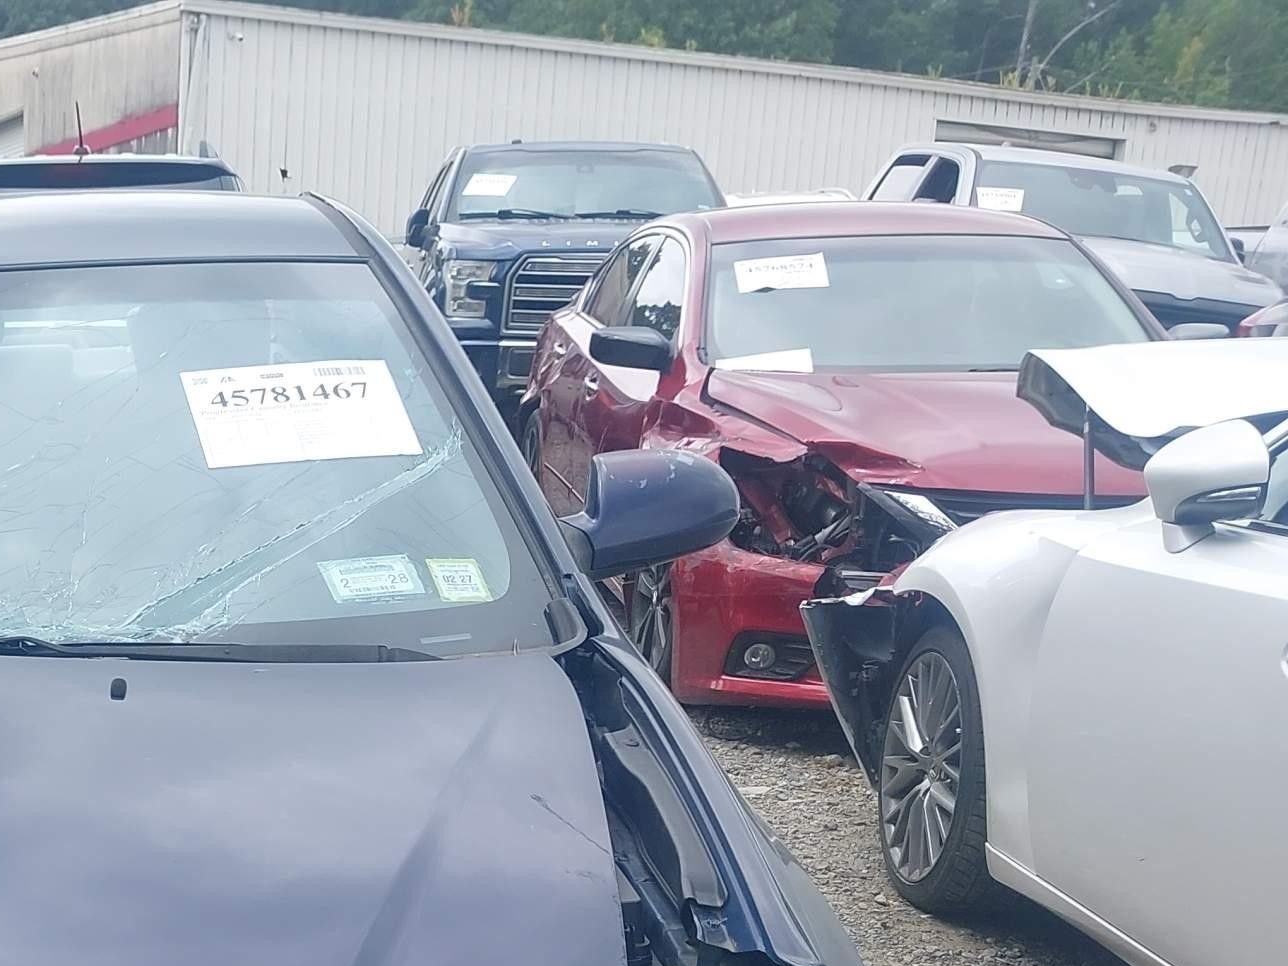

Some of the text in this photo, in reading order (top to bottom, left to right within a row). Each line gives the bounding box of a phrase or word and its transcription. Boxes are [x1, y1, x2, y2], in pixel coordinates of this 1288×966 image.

[210, 381, 367, 408] 45781467
[340, 577, 352, 589] 2
[387, 572, 409, 585] 28
[442, 574, 472, 584] 02 27
